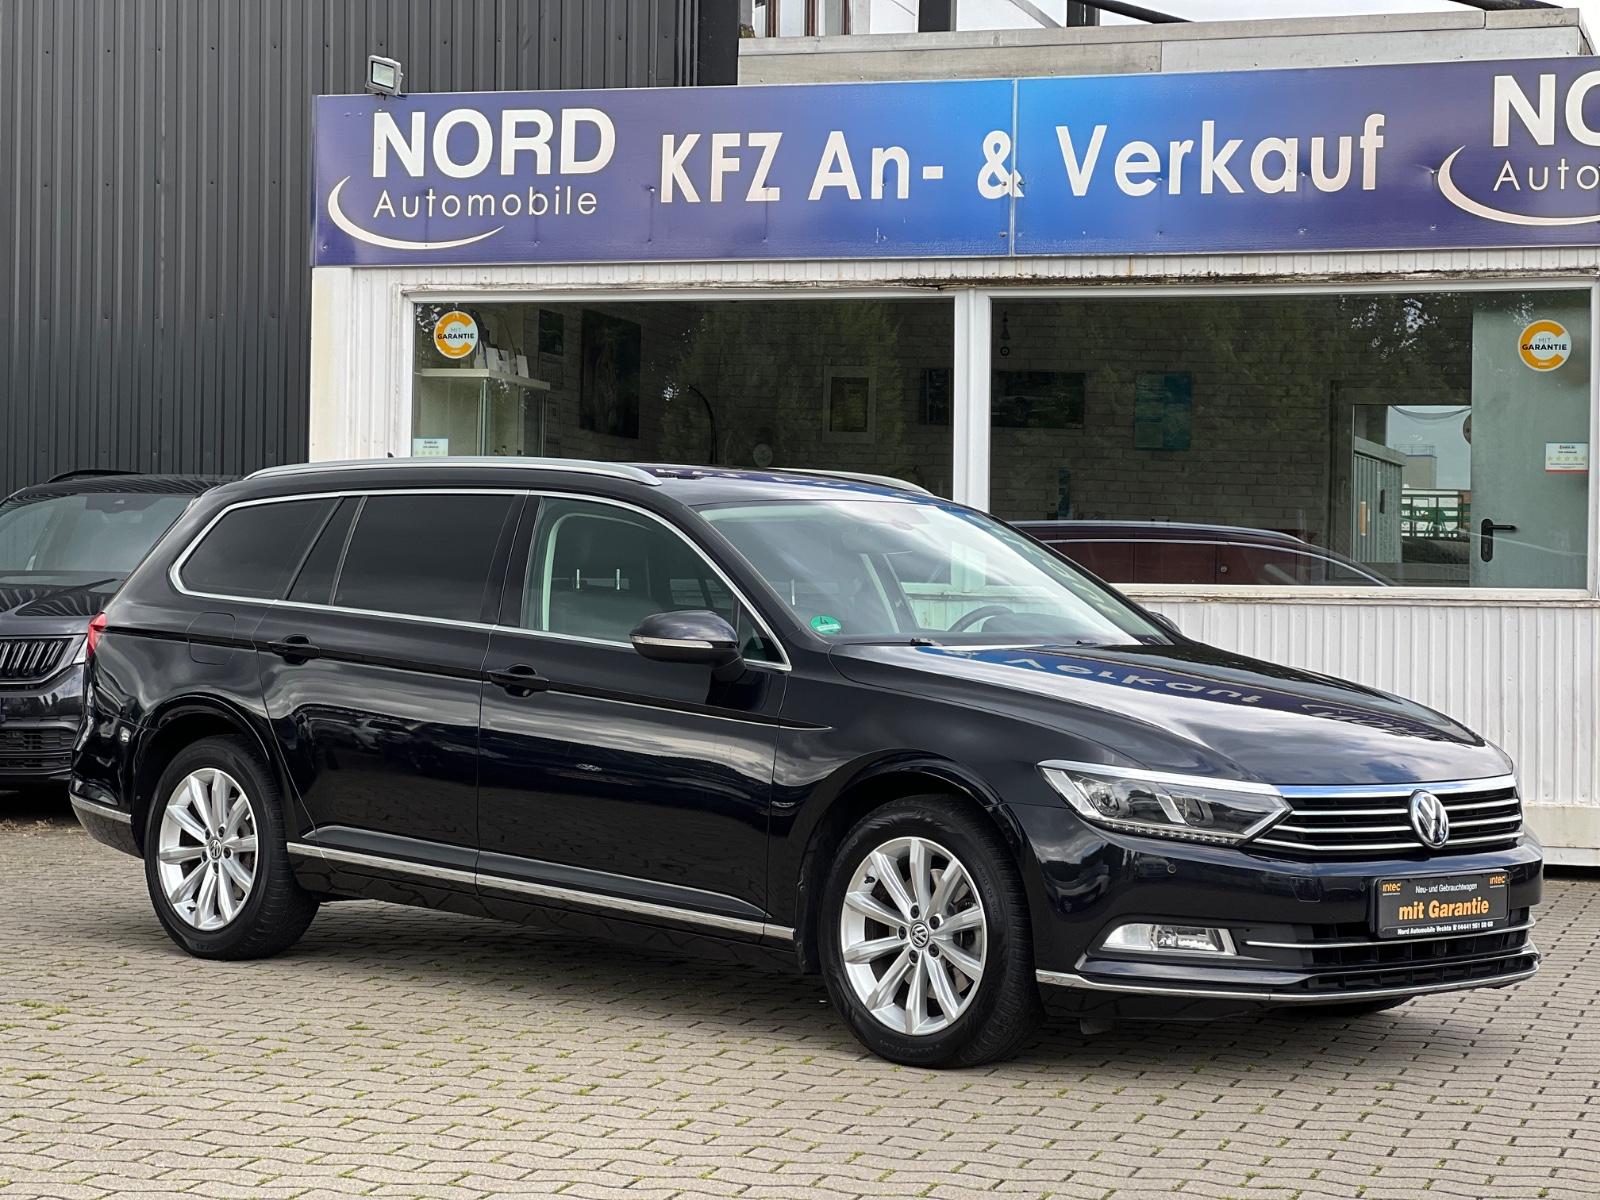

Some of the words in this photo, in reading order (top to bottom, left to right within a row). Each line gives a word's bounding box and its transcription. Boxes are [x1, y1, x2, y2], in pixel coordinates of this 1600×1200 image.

[372, 108, 617, 178] NORD
[660, 131, 783, 203] KFZ
[808, 130, 944, 201] An-
[976, 129, 1025, 199] &
[1055, 113, 1386, 198] Verkauf
[374, 184, 597, 218] Automobile
[1522, 343, 1567, 351] GARANTIE
[1383, 882, 1401, 892] intec
[1428, 885, 1439, 893] und
[1439, 883, 1478, 893] Gebrauchtwagen
[1399, 901, 1424, 920] mit
[1428, 897, 1489, 919] Garantie
[1410, 926, 1436, 934] Automobile
